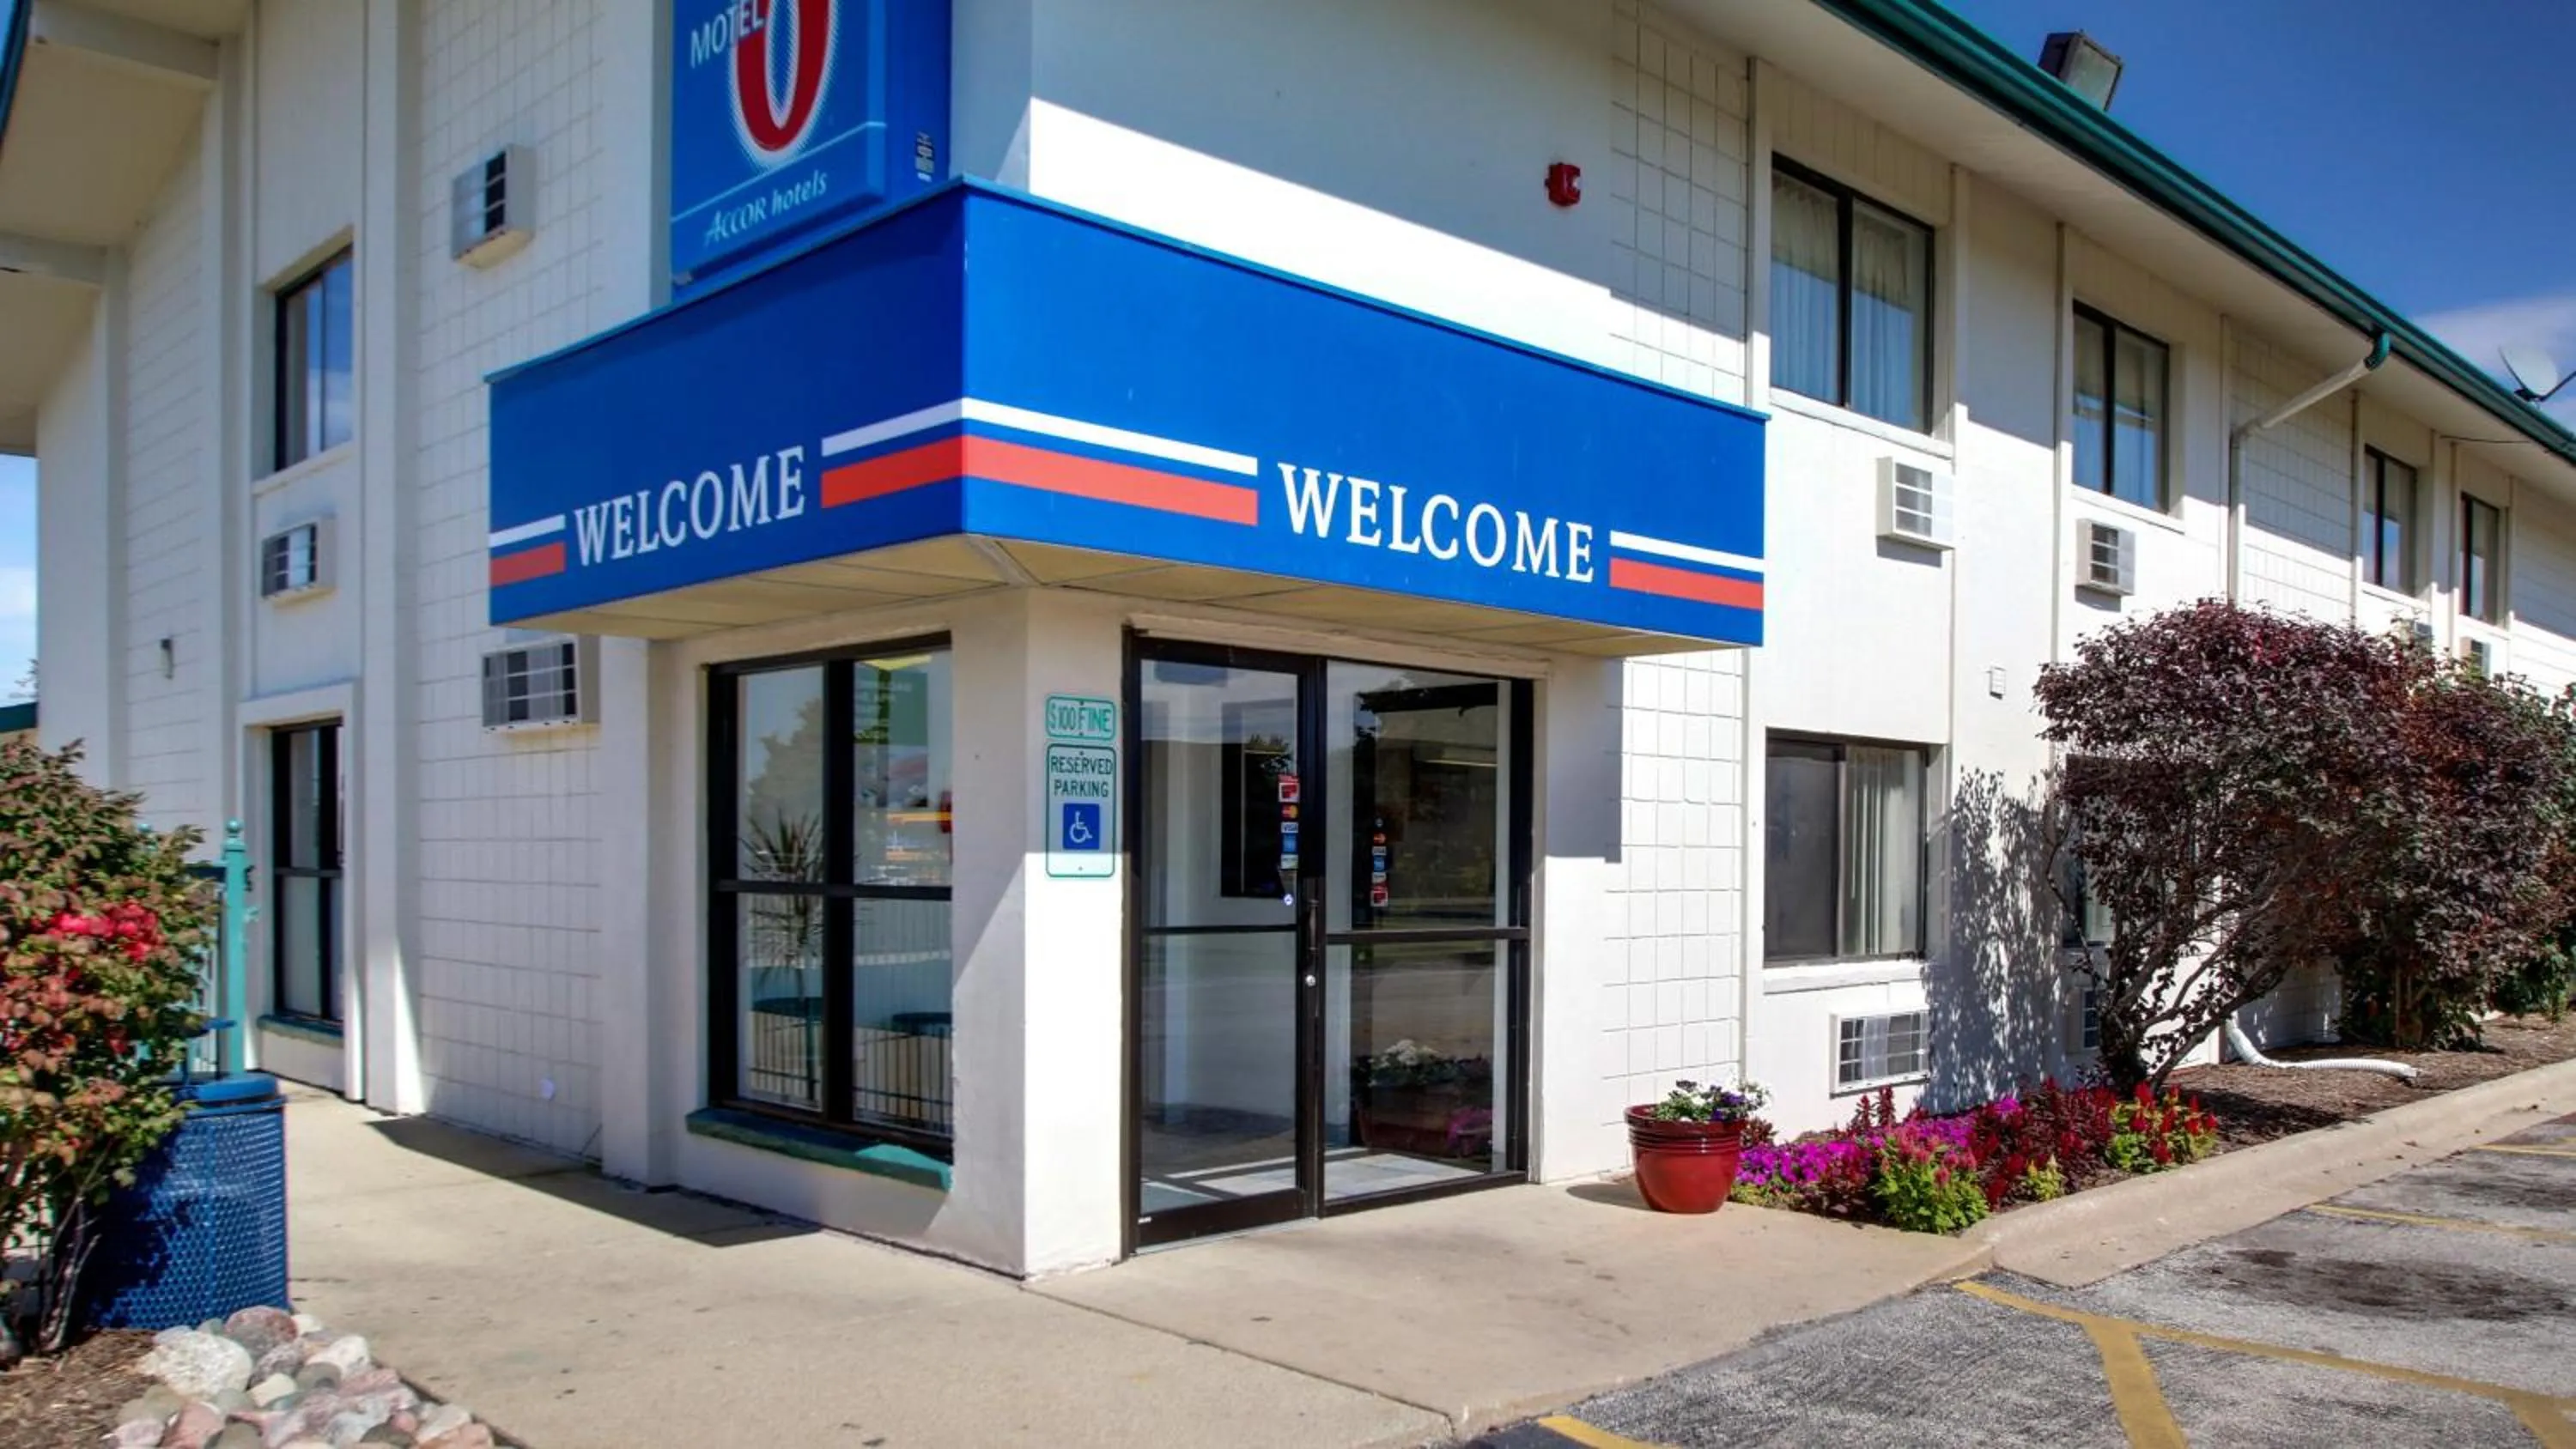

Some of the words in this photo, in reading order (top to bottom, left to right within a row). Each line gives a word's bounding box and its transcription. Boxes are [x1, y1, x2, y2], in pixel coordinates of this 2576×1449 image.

[690, 0, 764, 69] MOTEL
[771, 169, 827, 216] hotels
[574, 445, 805, 567] WELCOME
[1277, 462, 1595, 584] WELCOME
[1078, 706, 1112, 732] FINE
[1050, 755, 1114, 775] RESERVED
[1054, 778, 1109, 797] PARKING
